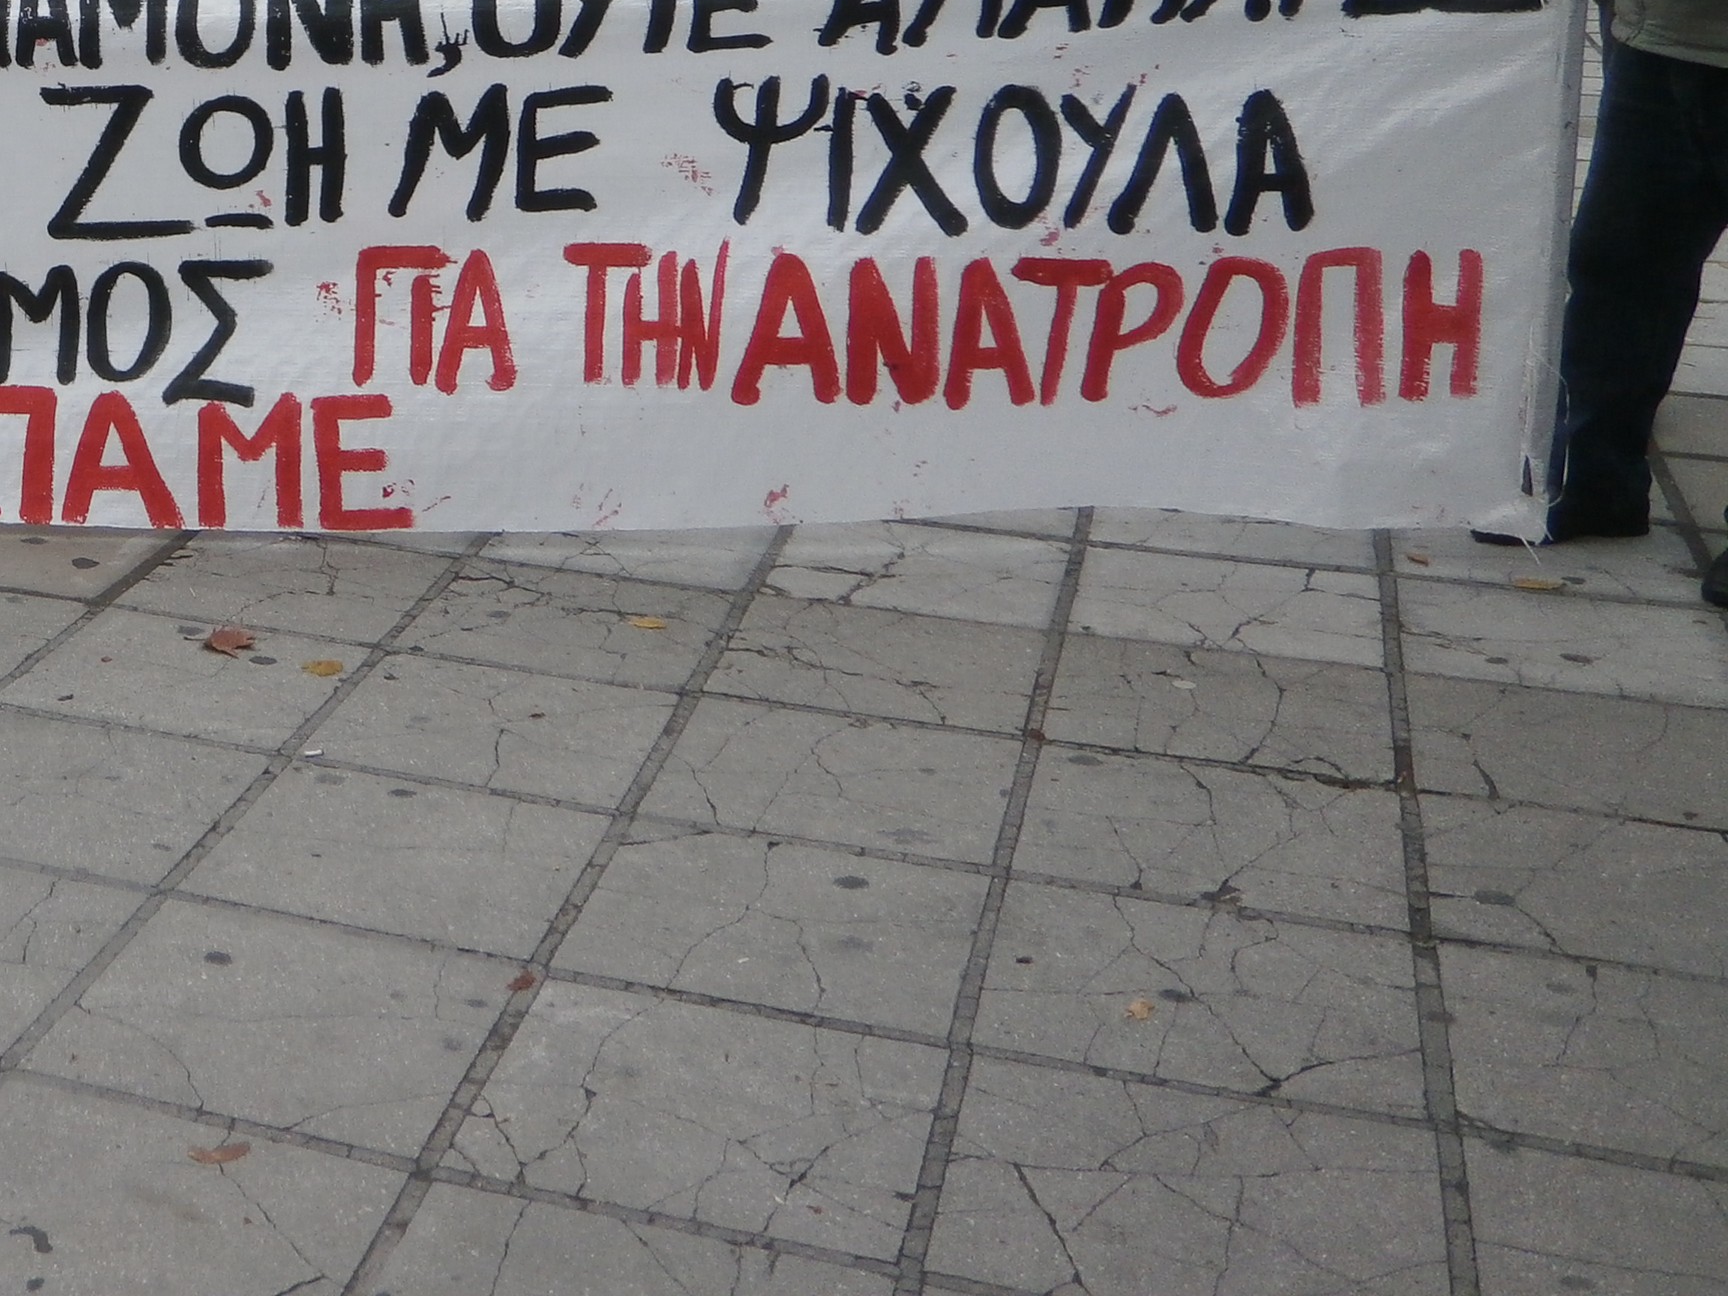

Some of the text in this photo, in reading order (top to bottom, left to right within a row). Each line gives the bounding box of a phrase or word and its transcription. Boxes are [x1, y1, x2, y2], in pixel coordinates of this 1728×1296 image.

[387, 84, 614, 223] ΜΕ
[712, 73, 1315, 238] ΨΙΧΟΥΛΑ
[353, 245, 517, 395] ΓΙΑ
[564, 242, 730, 390] ΤΗΝ
[732, 248, 1483, 410] ΑΝΑΤΡΟΠΗ
